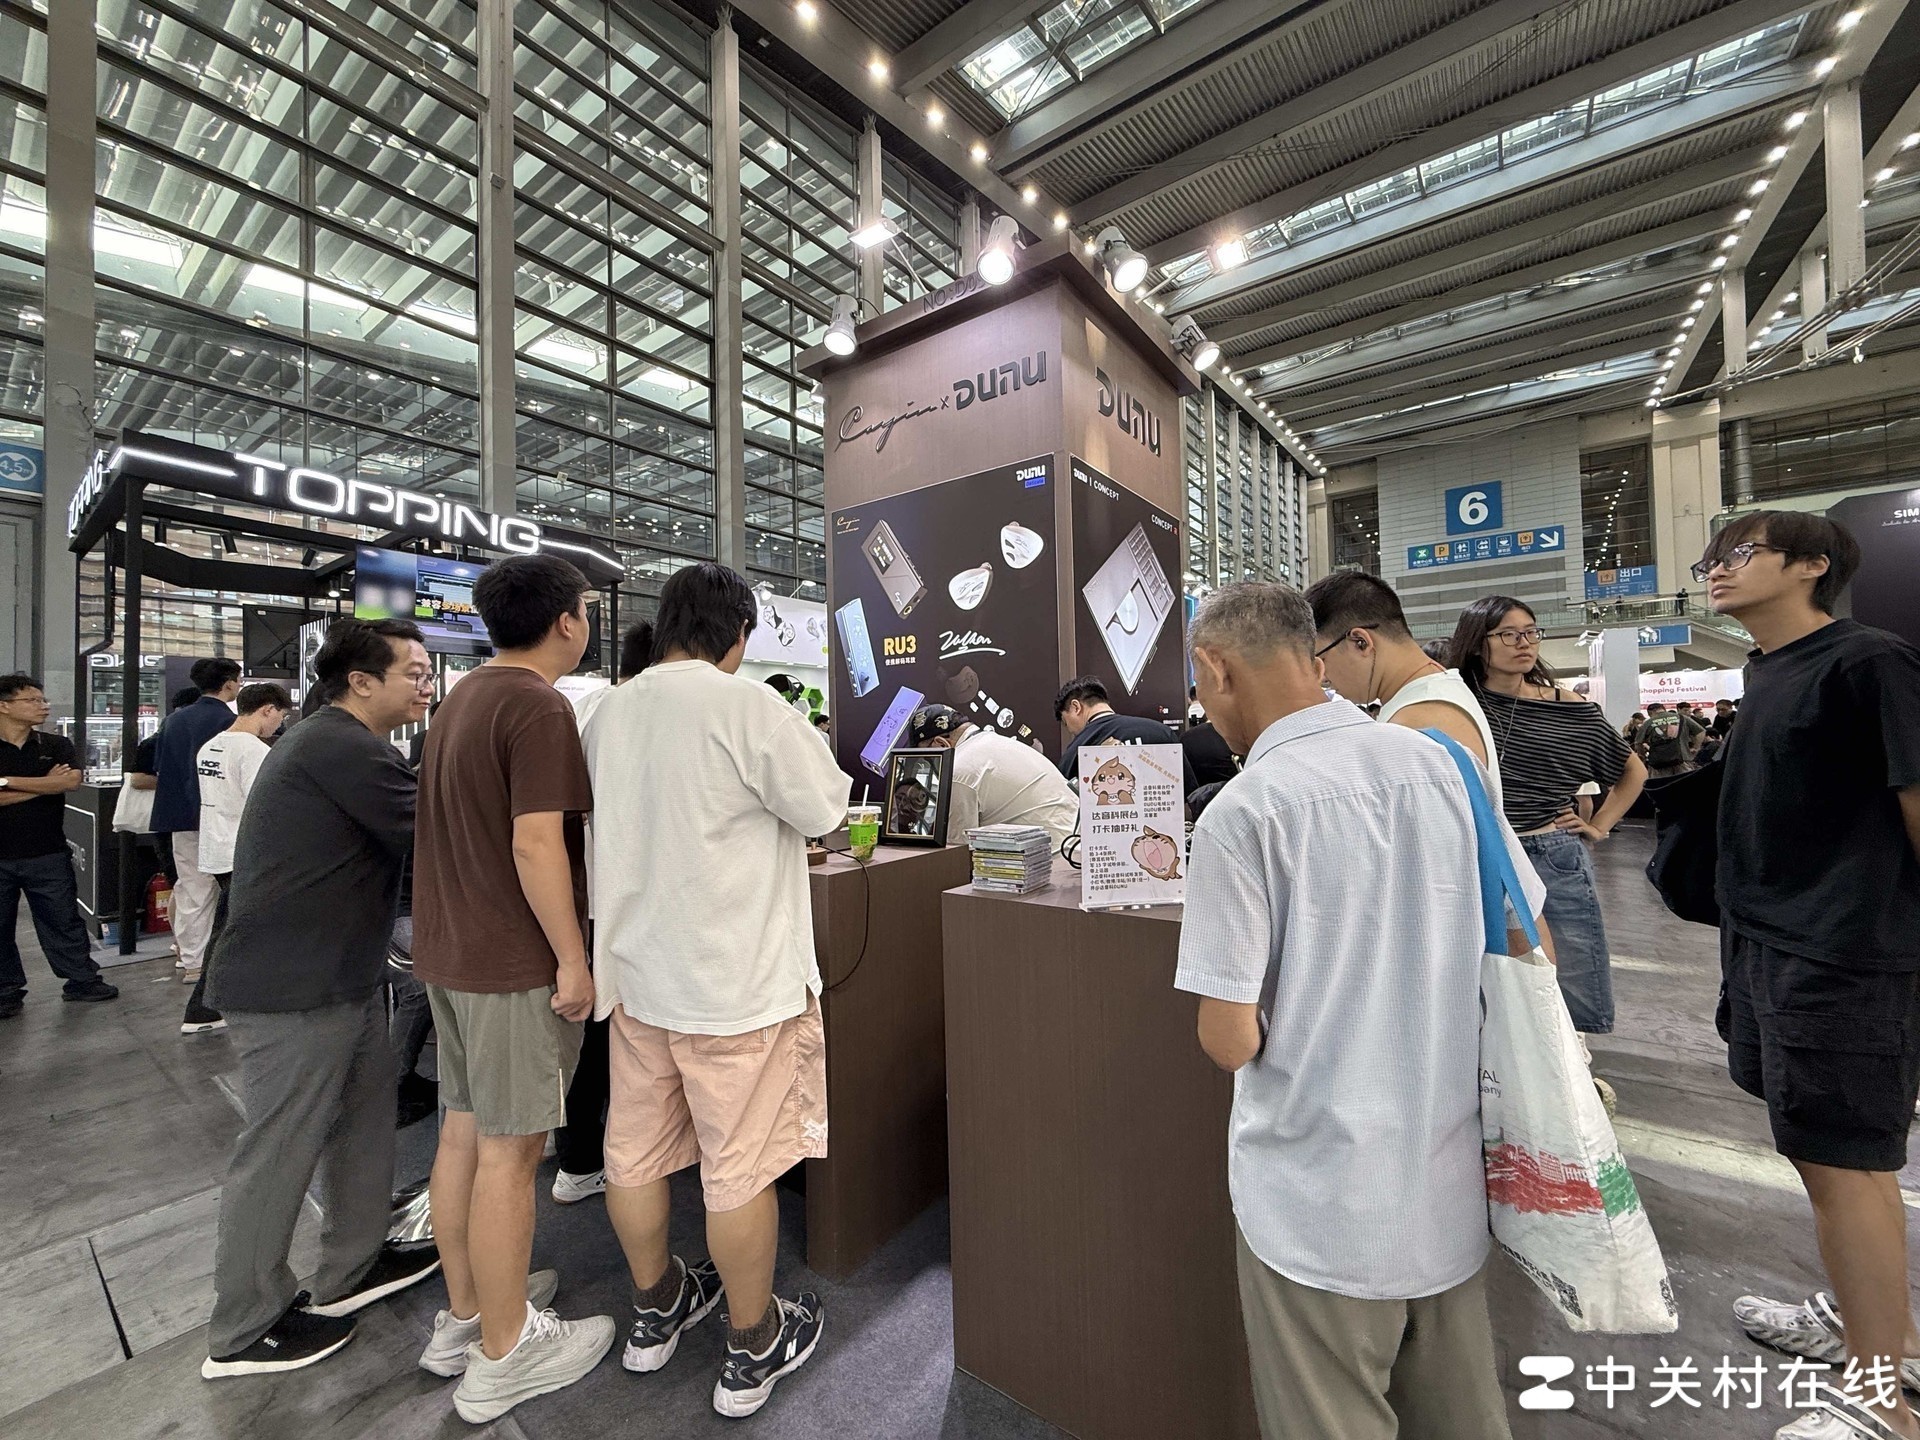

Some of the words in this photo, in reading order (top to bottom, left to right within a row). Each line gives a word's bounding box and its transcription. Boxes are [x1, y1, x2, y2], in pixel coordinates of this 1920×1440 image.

[953, 350, 1046, 411] DUNU
[1096, 366, 1161, 457] DUNU
[1016, 464, 1046, 482] DUNU
[1093, 480, 1119, 501] CONCEPT
[234, 451, 541, 554] TOPPING
[1459, 491, 1489, 526] 6
[1151, 514, 1173, 532] CONCEPT
[1620, 568, 1642, 578] 出口
[884, 635, 917, 656] RU3
[1659, 677, 1682, 686] 618
[1092, 810, 1139, 820] 达音科展台
[1092, 824, 1140, 834] 打卡抽好礼
[784, 1338, 797, 1362] N
